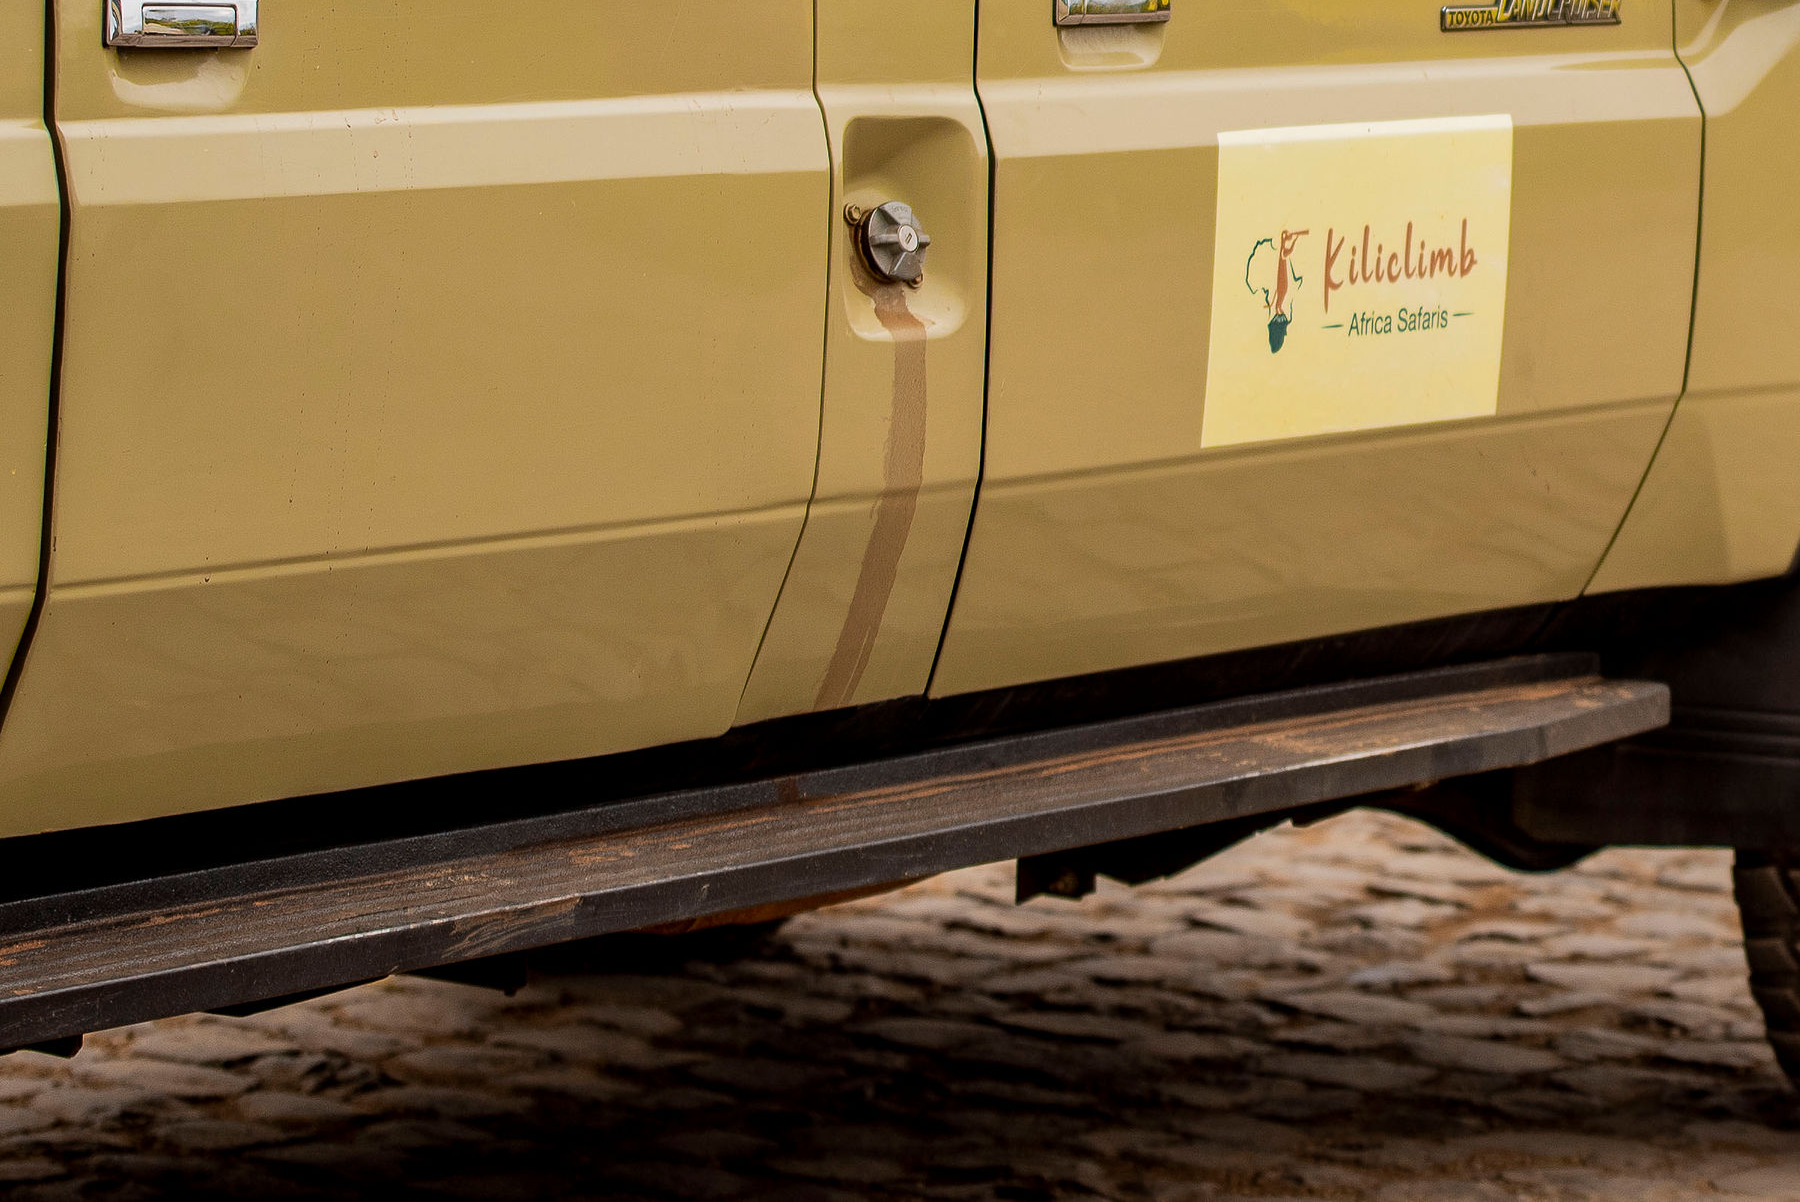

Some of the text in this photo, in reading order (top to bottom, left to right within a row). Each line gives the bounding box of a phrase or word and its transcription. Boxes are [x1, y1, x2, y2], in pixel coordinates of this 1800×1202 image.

[1448, 8, 1496, 26] TOYOTA
[1322, 217, 1479, 315] Kiliclimb
[1347, 304, 1449, 337] Africa Safaris
